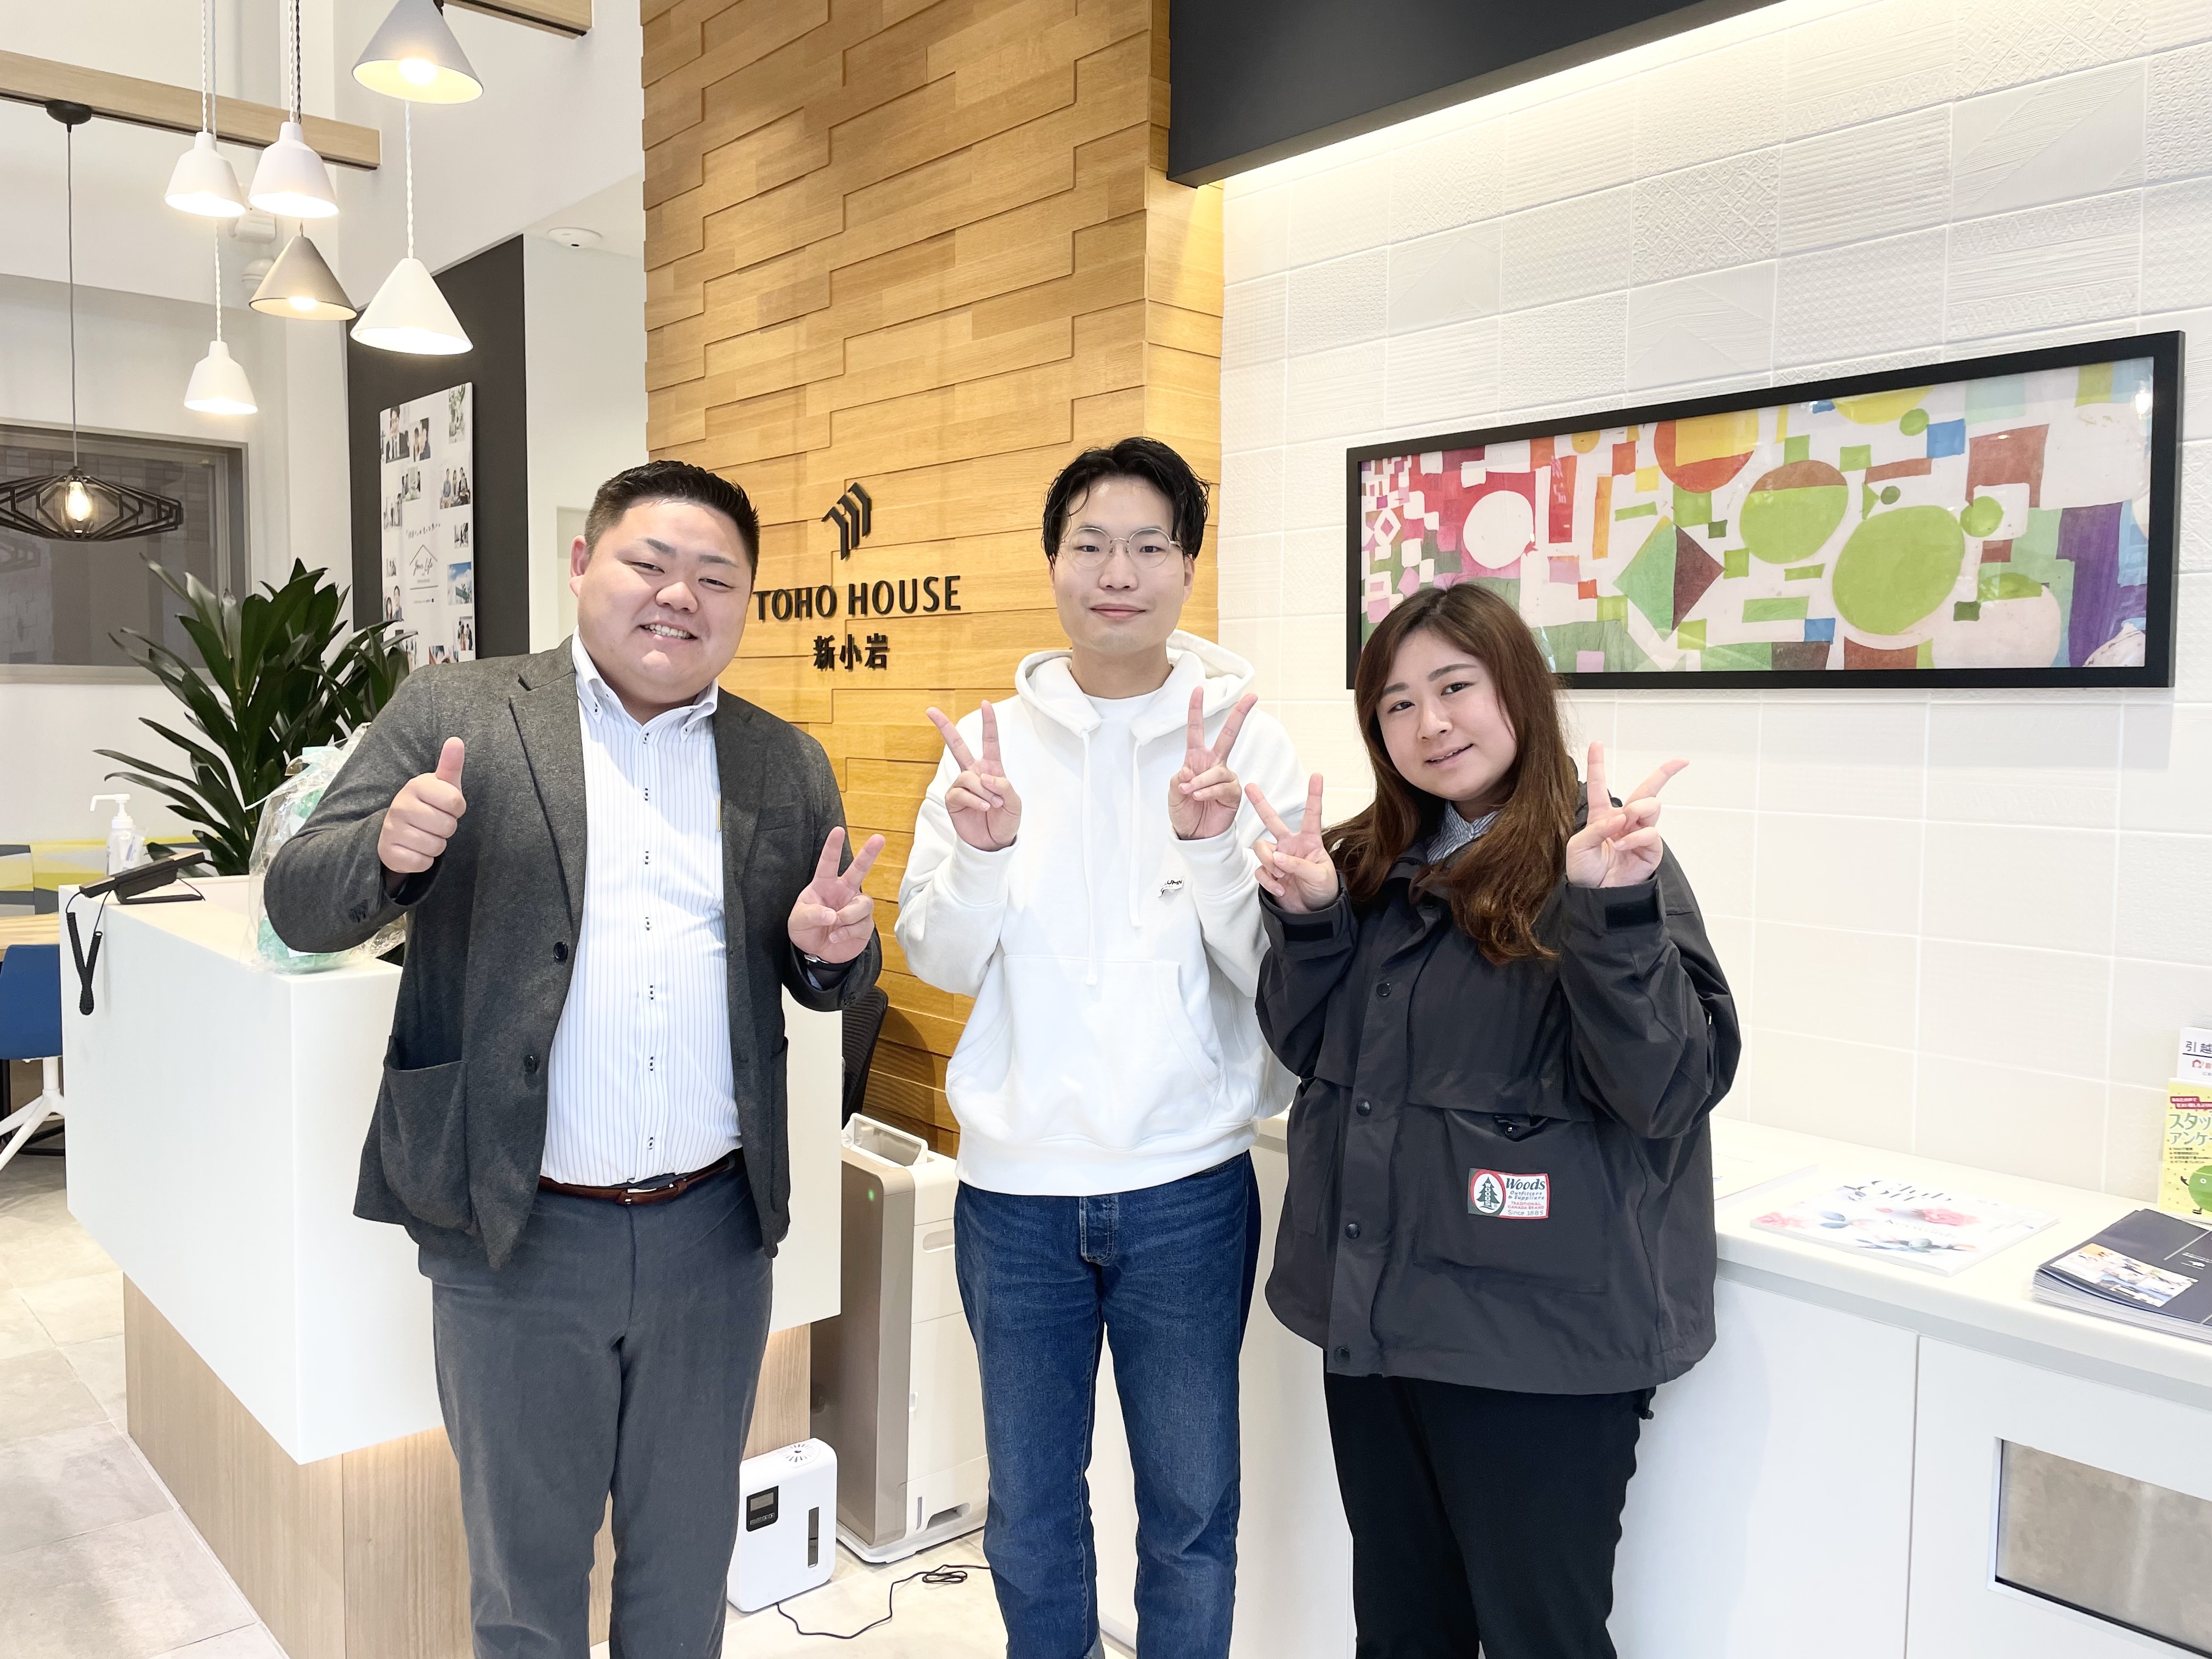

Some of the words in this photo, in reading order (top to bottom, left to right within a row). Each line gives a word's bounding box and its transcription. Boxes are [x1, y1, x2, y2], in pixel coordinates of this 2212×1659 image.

[754, 585, 837, 622] TOHO
[848, 575, 961, 616] HOUSE
[813, 633, 890, 671] 新小岩
[1506, 1178, 1545, 1190] Woods
